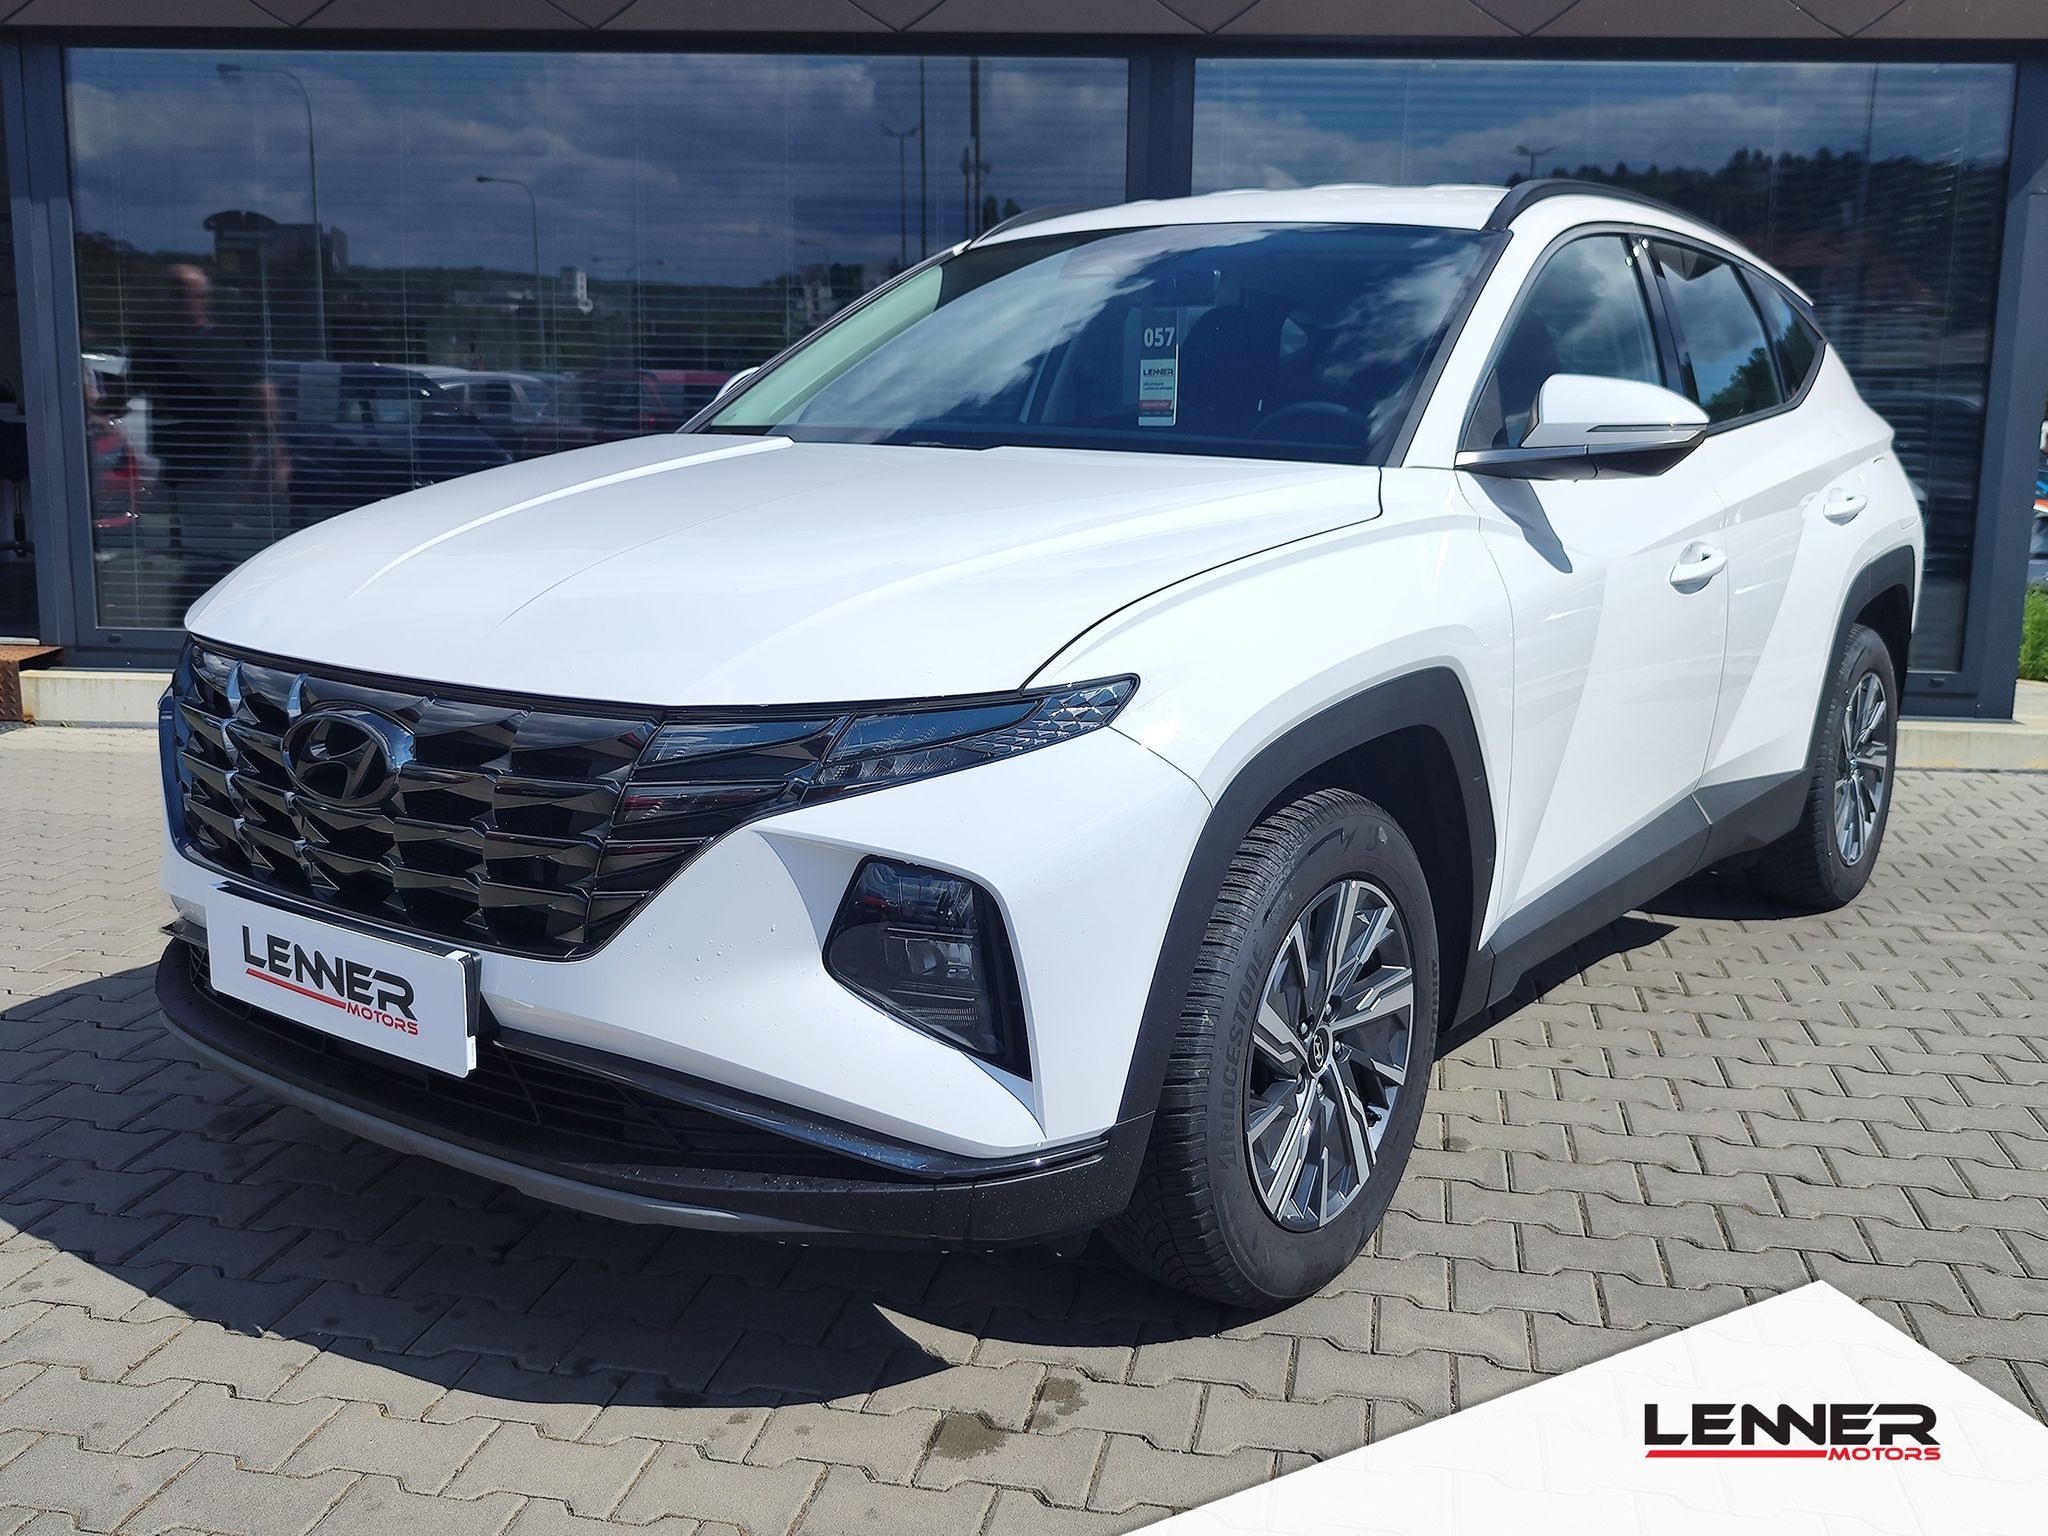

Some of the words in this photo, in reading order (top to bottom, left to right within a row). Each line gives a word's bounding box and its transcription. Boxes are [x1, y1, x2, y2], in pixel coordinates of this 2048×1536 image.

[1143, 327, 1175, 348] 057
[1142, 368, 1174, 376] LENNER
[241, 924, 418, 1021] LENNER
[346, 1000, 420, 1037] MOTORS
[1216, 942, 1267, 1170] BRIDGESTONE
